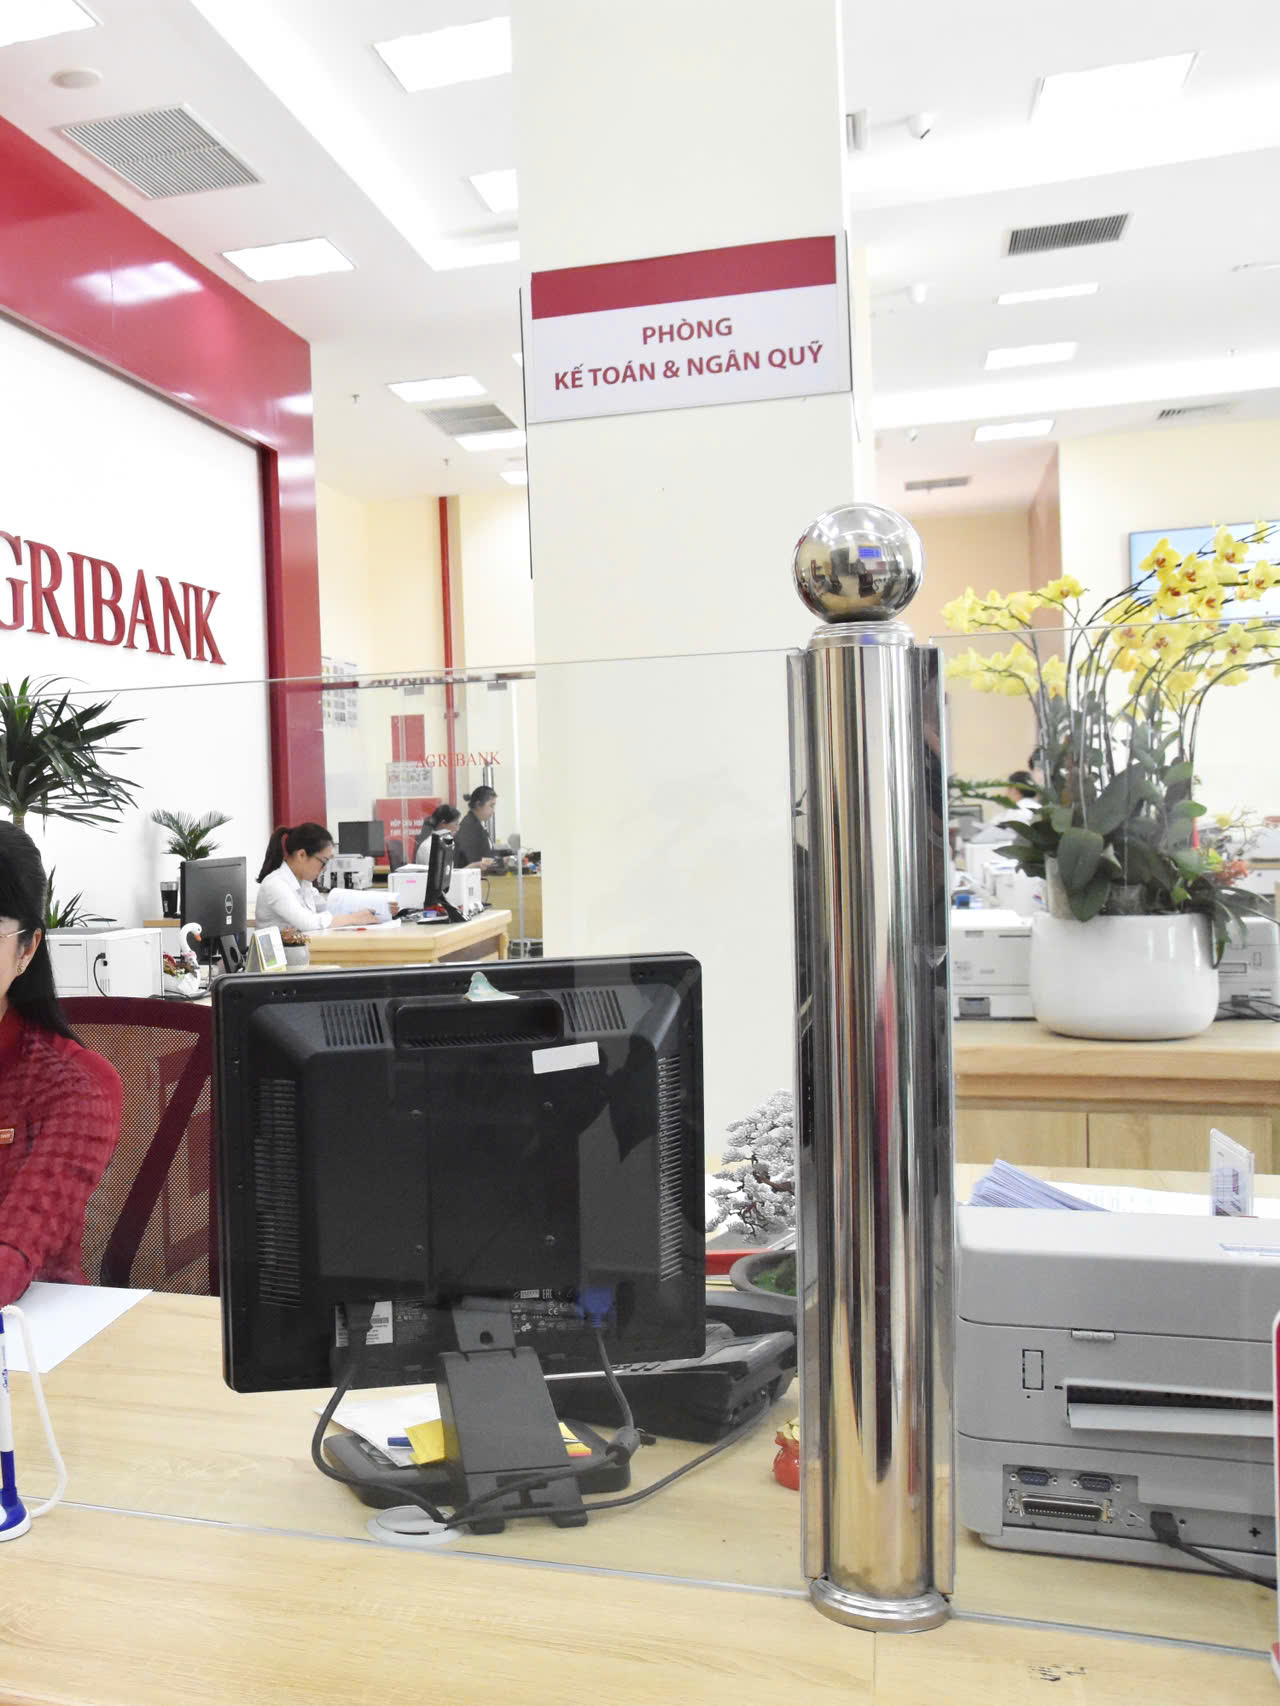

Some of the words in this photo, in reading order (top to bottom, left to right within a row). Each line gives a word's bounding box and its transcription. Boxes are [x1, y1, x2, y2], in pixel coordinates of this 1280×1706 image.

[641, 317, 733, 345] PHÒNG
[554, 363, 584, 391] KẾ
[588, 358, 656, 387] TOÁN
[662, 359, 680, 379] &
[686, 350, 760, 376] NGÂN
[767, 340, 823, 369] QUỸ
